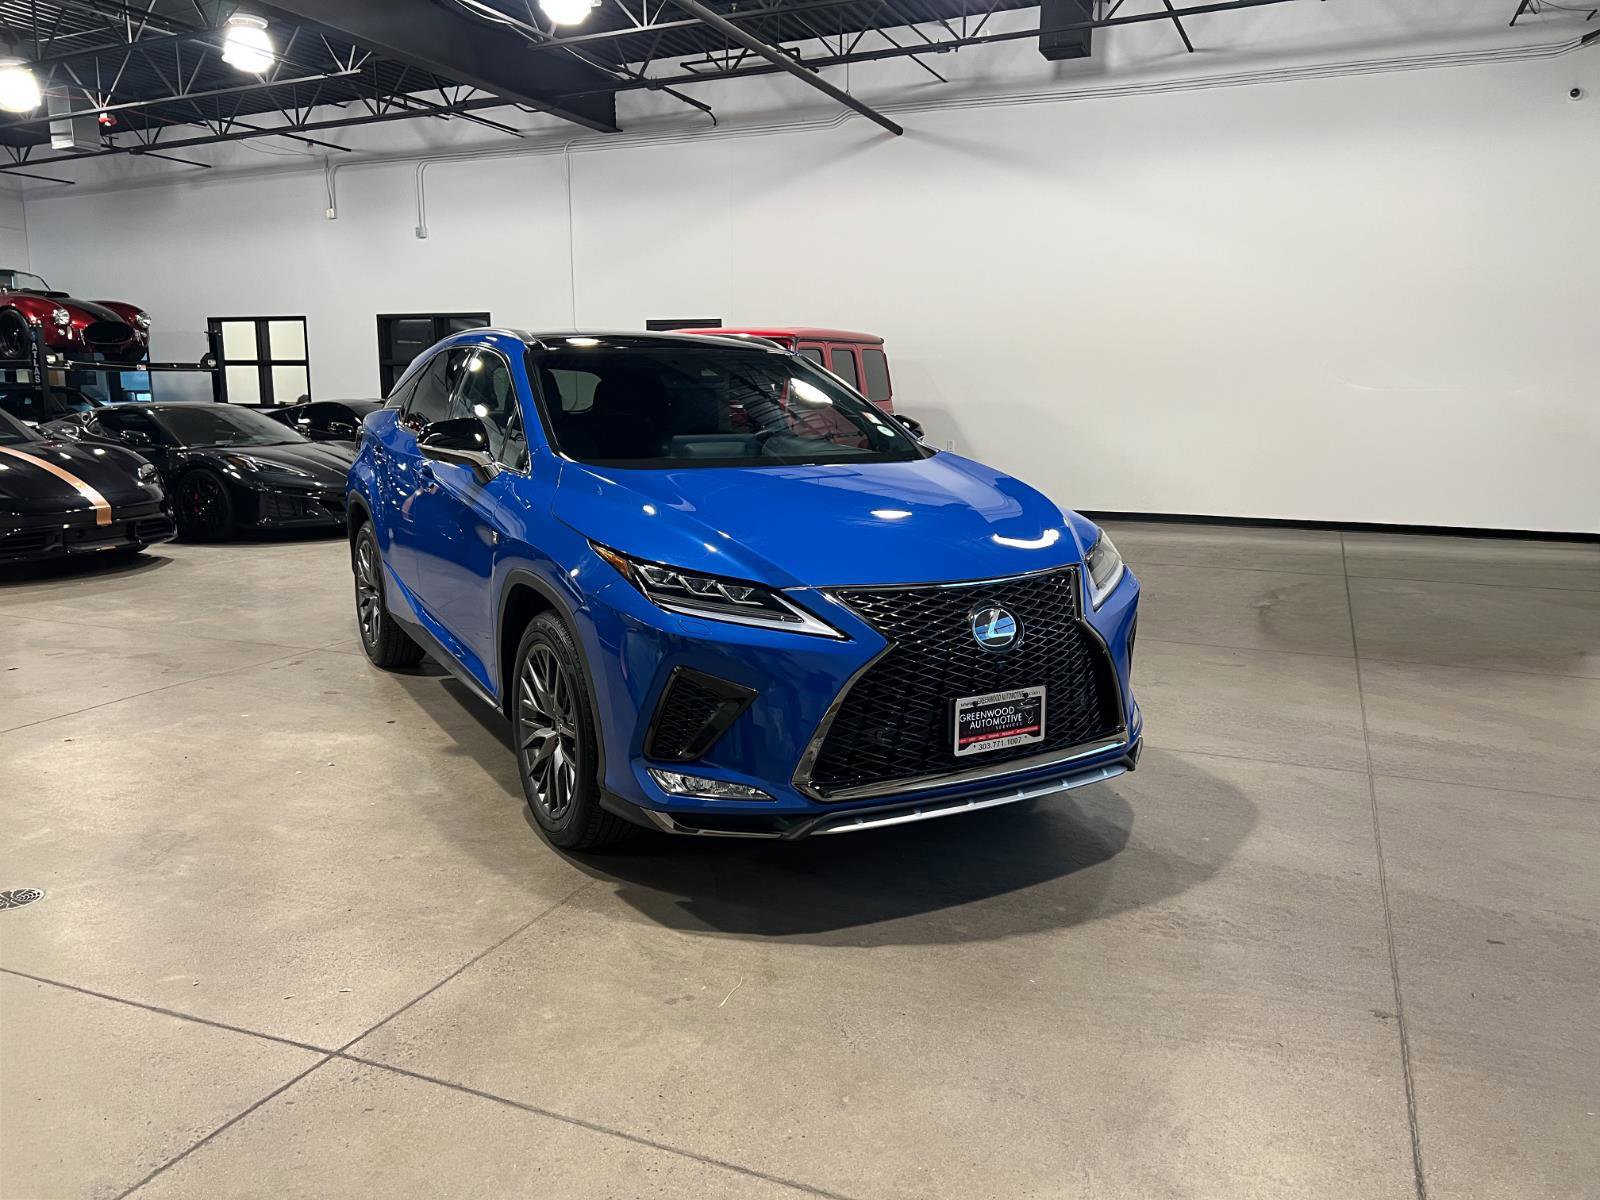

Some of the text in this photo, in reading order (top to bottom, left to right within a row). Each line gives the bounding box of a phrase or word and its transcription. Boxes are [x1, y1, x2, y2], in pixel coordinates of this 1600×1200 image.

[31, 342, 41, 383] ATLAS
[959, 706, 1015, 723] GREENWOOD
[969, 712, 1023, 730] AUTOMOTIVE
[995, 722, 1022, 730] SERVICES
[978, 737, 1022, 750] 303.771.1007
